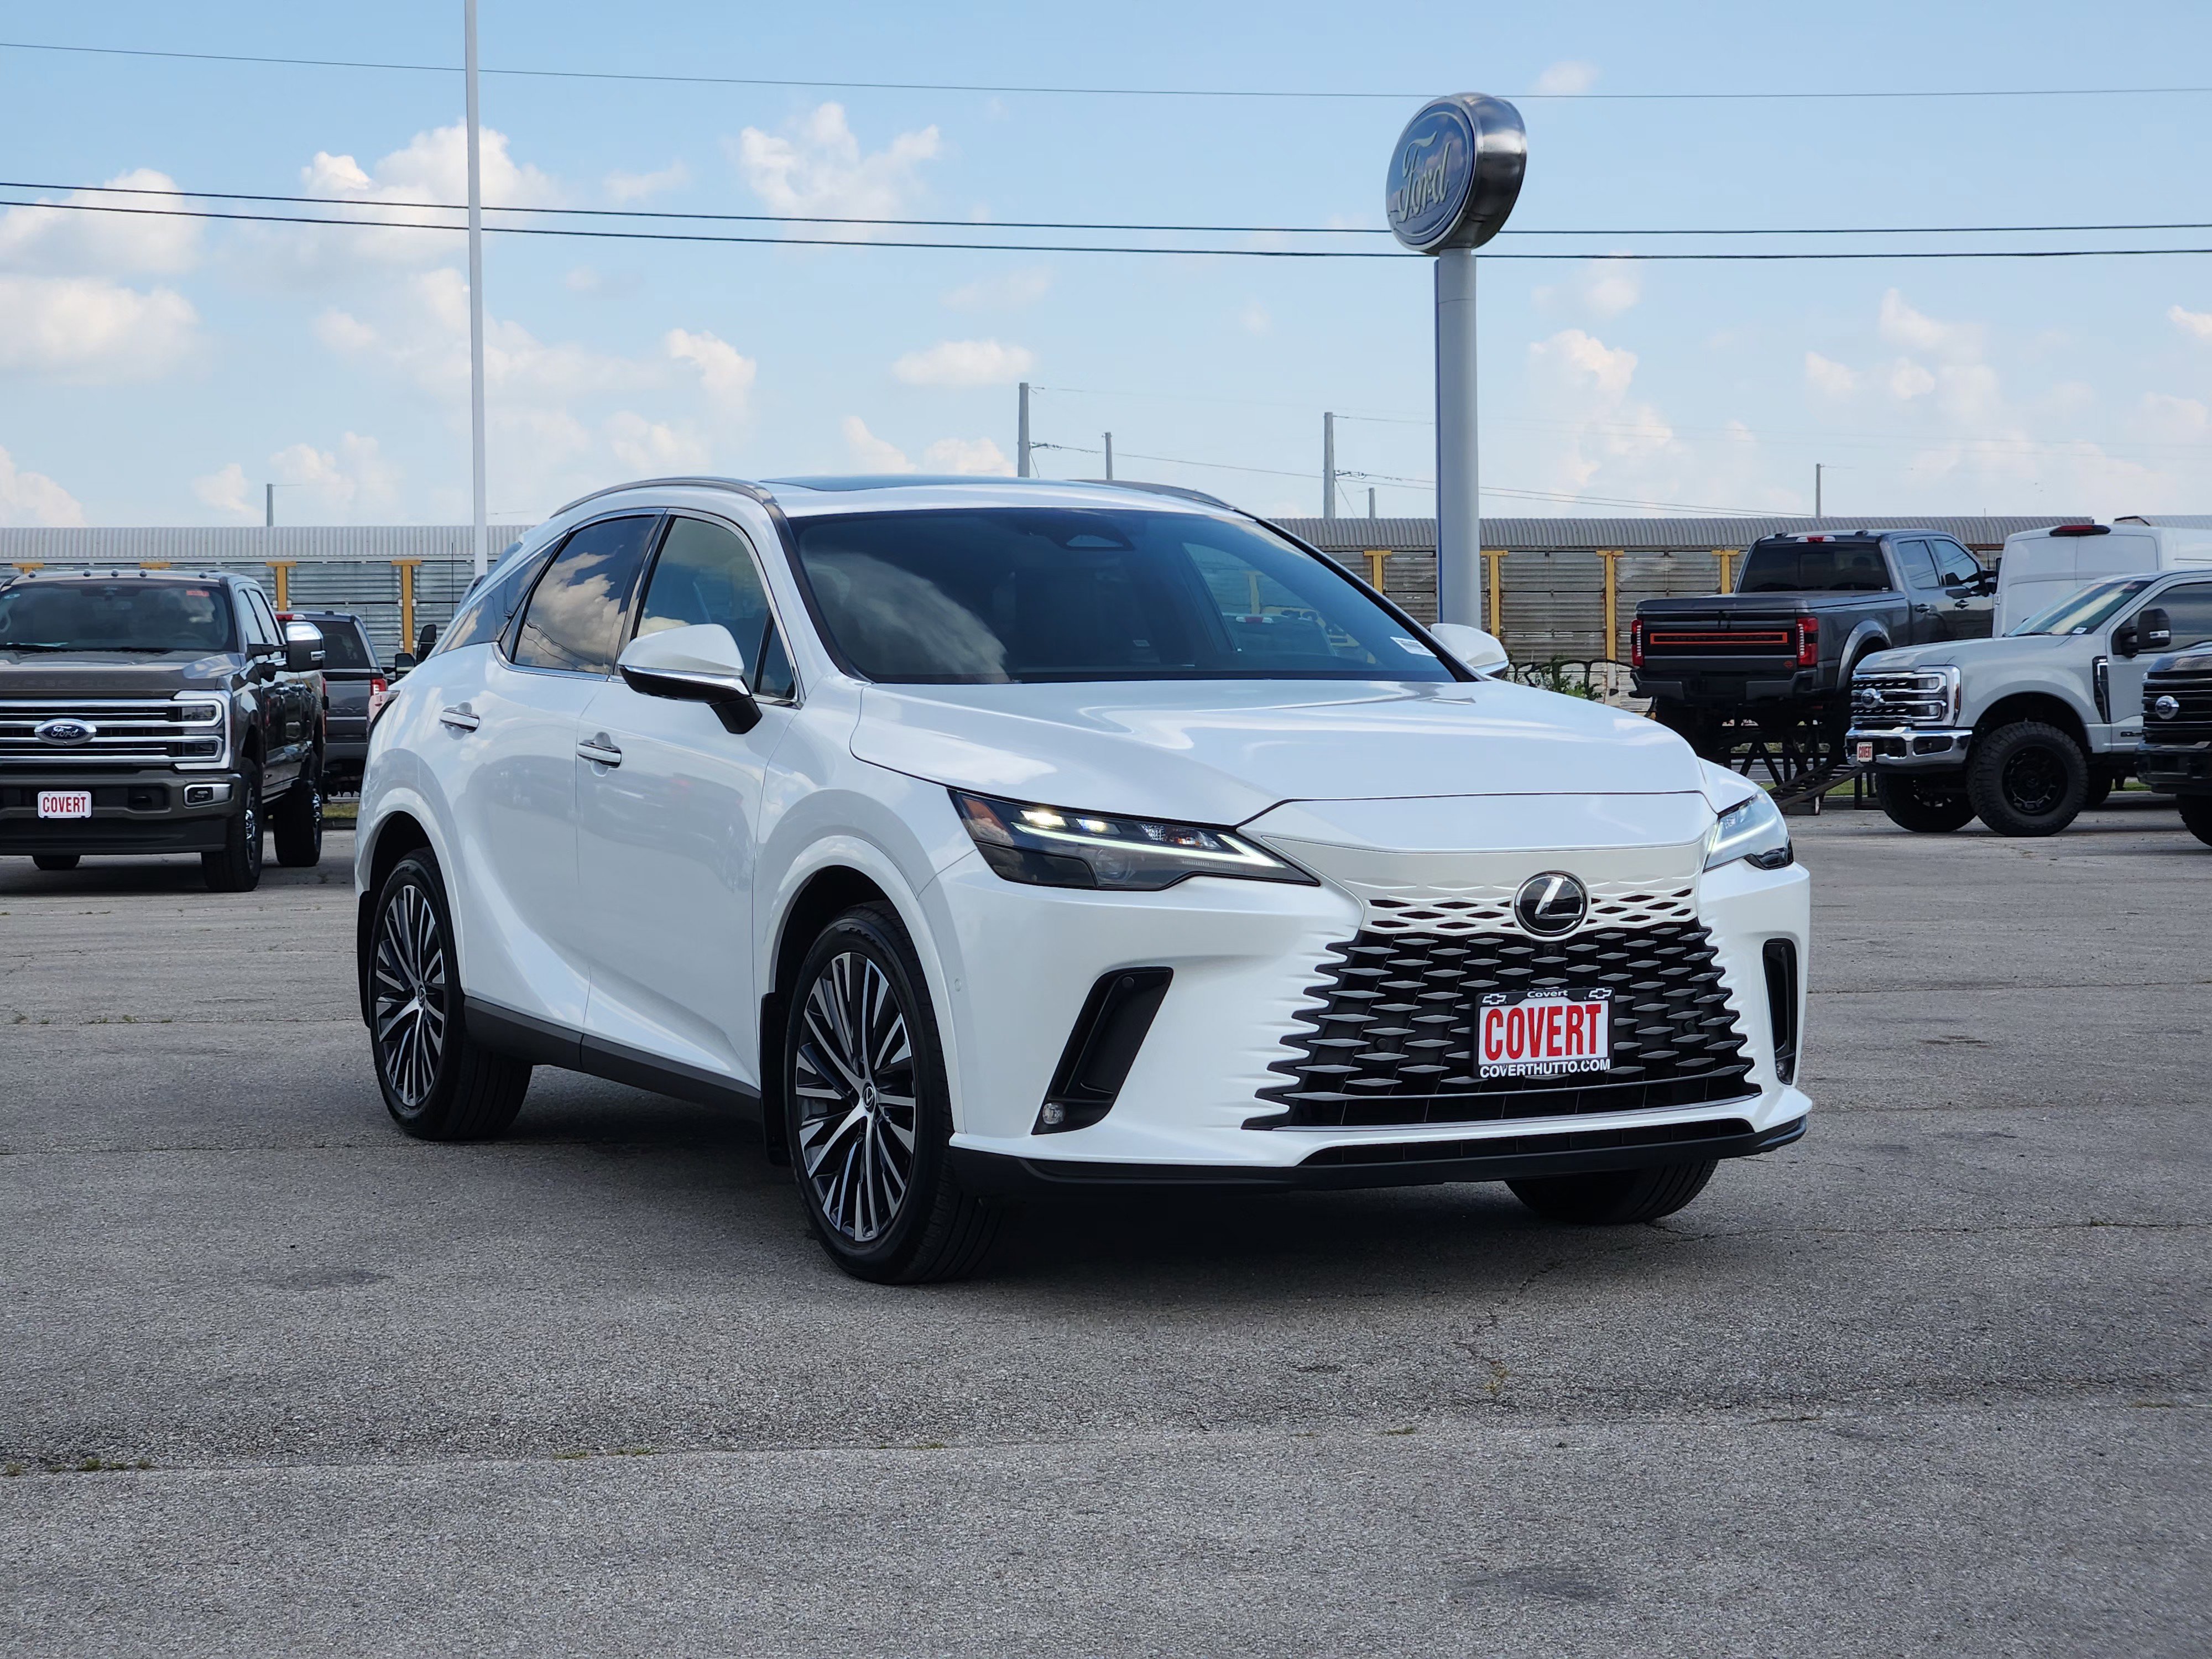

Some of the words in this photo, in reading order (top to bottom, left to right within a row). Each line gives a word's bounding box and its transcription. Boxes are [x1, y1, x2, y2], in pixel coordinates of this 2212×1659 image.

[1398, 131, 1452, 222] Ford
[51, 725, 79, 737] Ford
[43, 796, 86, 813] COVERT
[1527, 989, 1568, 998] Covert
[1485, 1004, 1601, 1061] COVERT
[1480, 1058, 1610, 1078] COVERTHUTTO.COM
